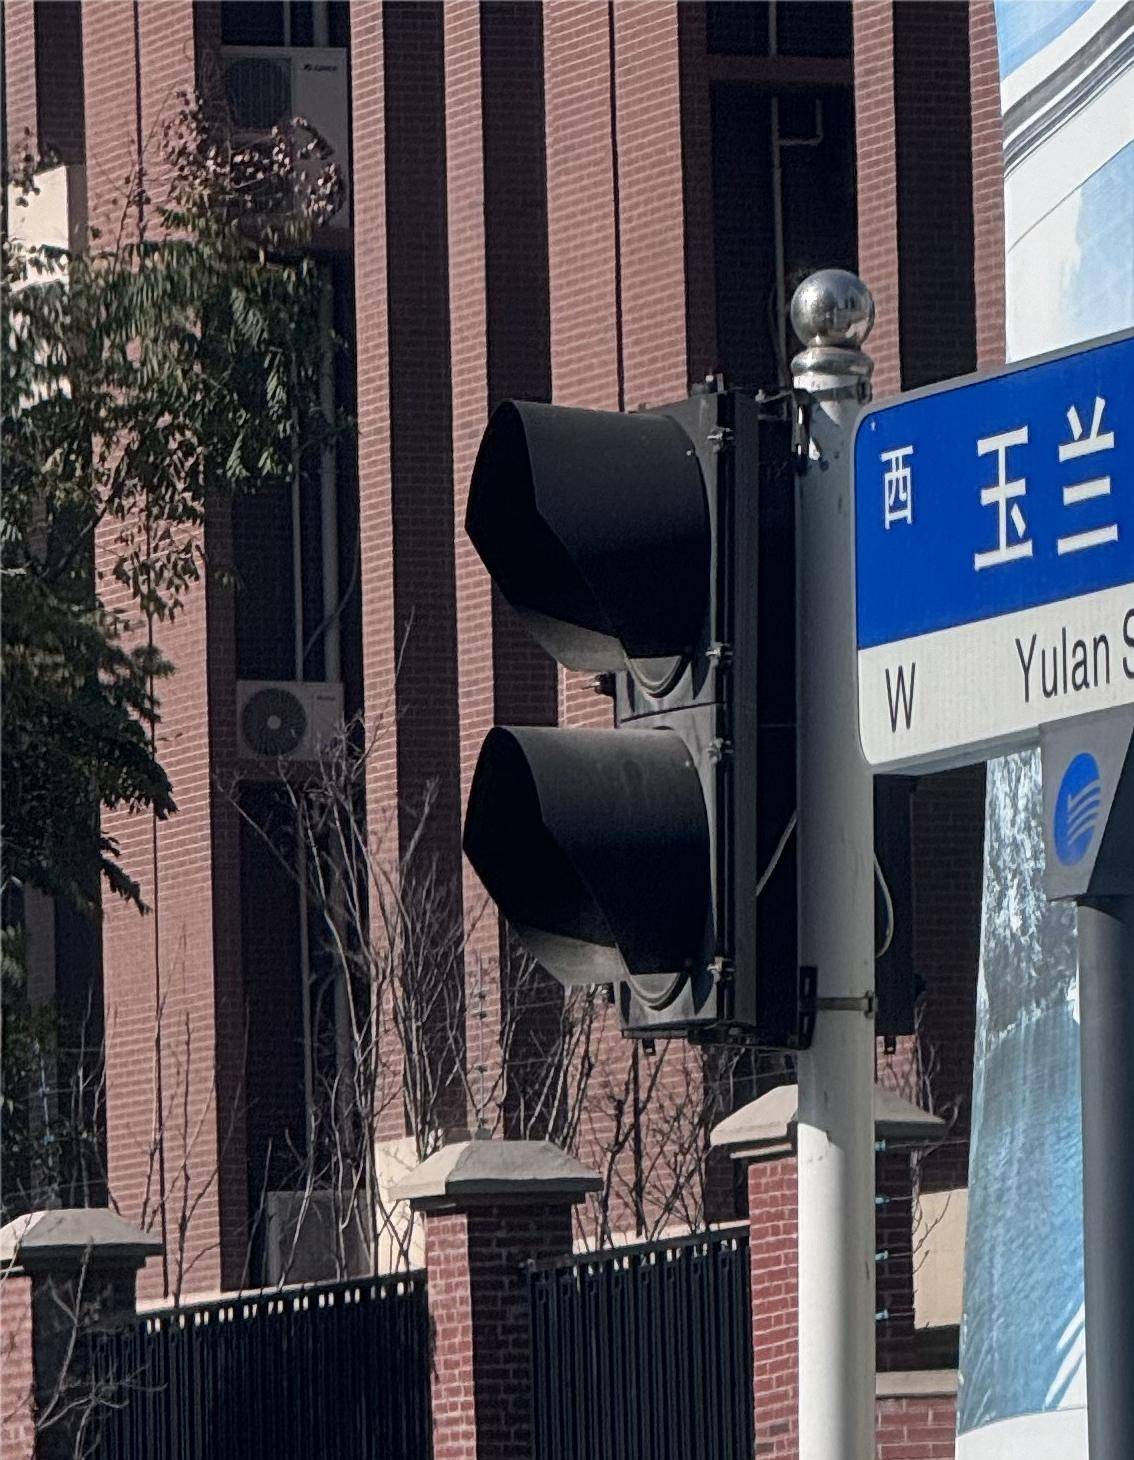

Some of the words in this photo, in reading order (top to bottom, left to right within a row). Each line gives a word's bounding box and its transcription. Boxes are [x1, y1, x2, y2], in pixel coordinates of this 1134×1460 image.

[880, 444, 914, 530] 西
[885, 662, 917, 733] W
[1015, 627, 1111, 702] Yulan
